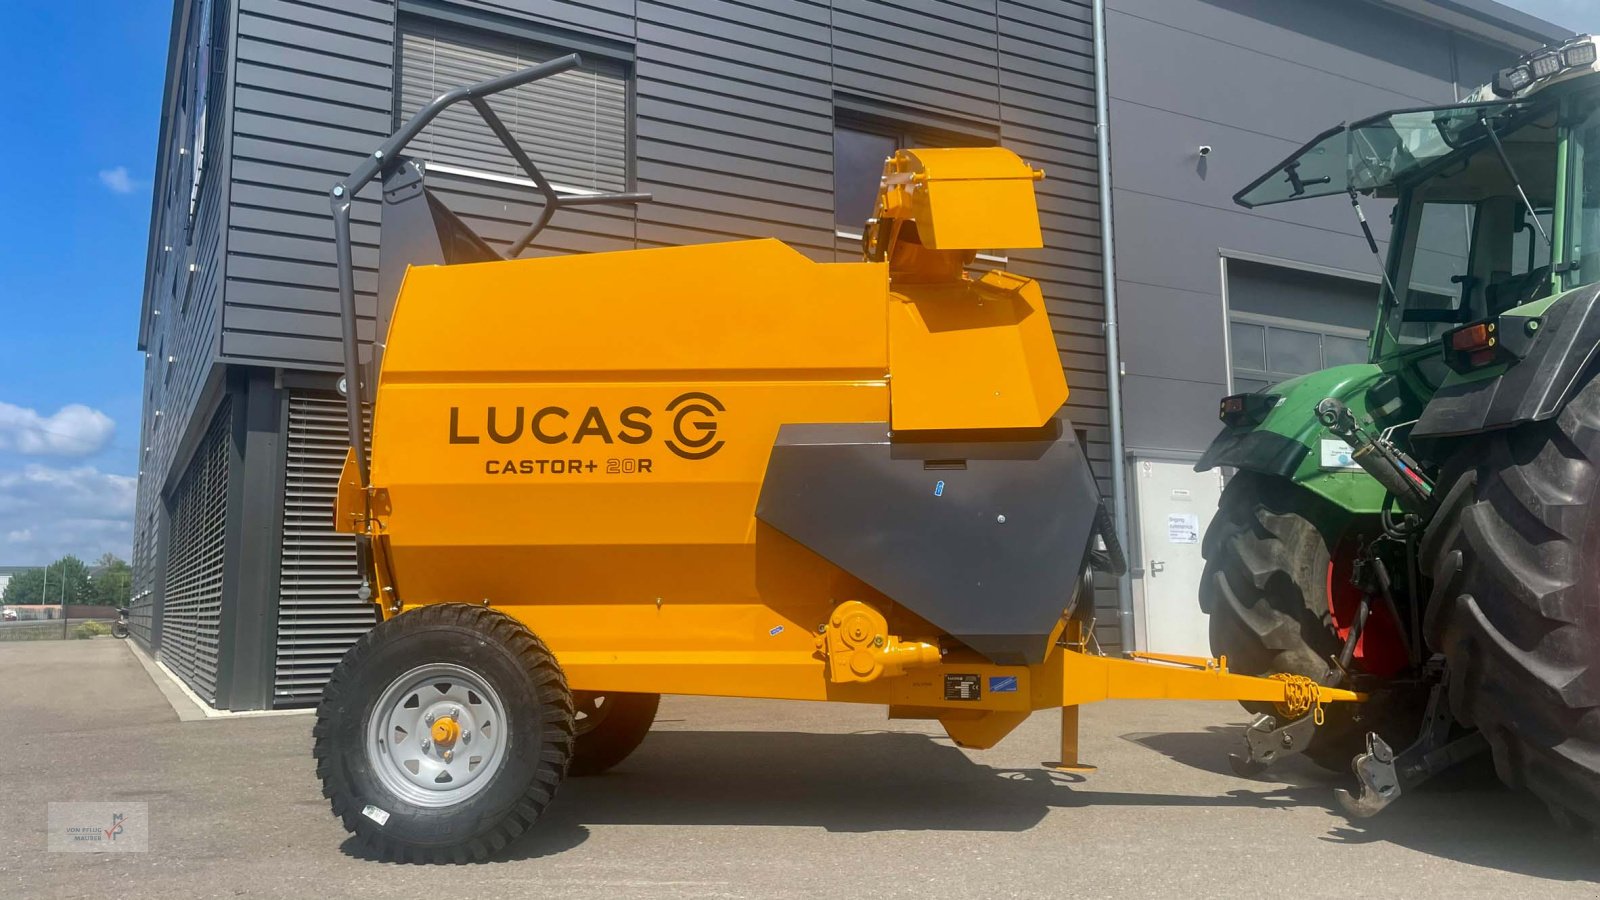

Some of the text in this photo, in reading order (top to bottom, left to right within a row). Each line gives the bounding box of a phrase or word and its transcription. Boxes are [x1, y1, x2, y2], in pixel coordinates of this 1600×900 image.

[448, 405, 653, 445] LUCAS
[485, 458, 653, 475] CASTOR+ 20R
